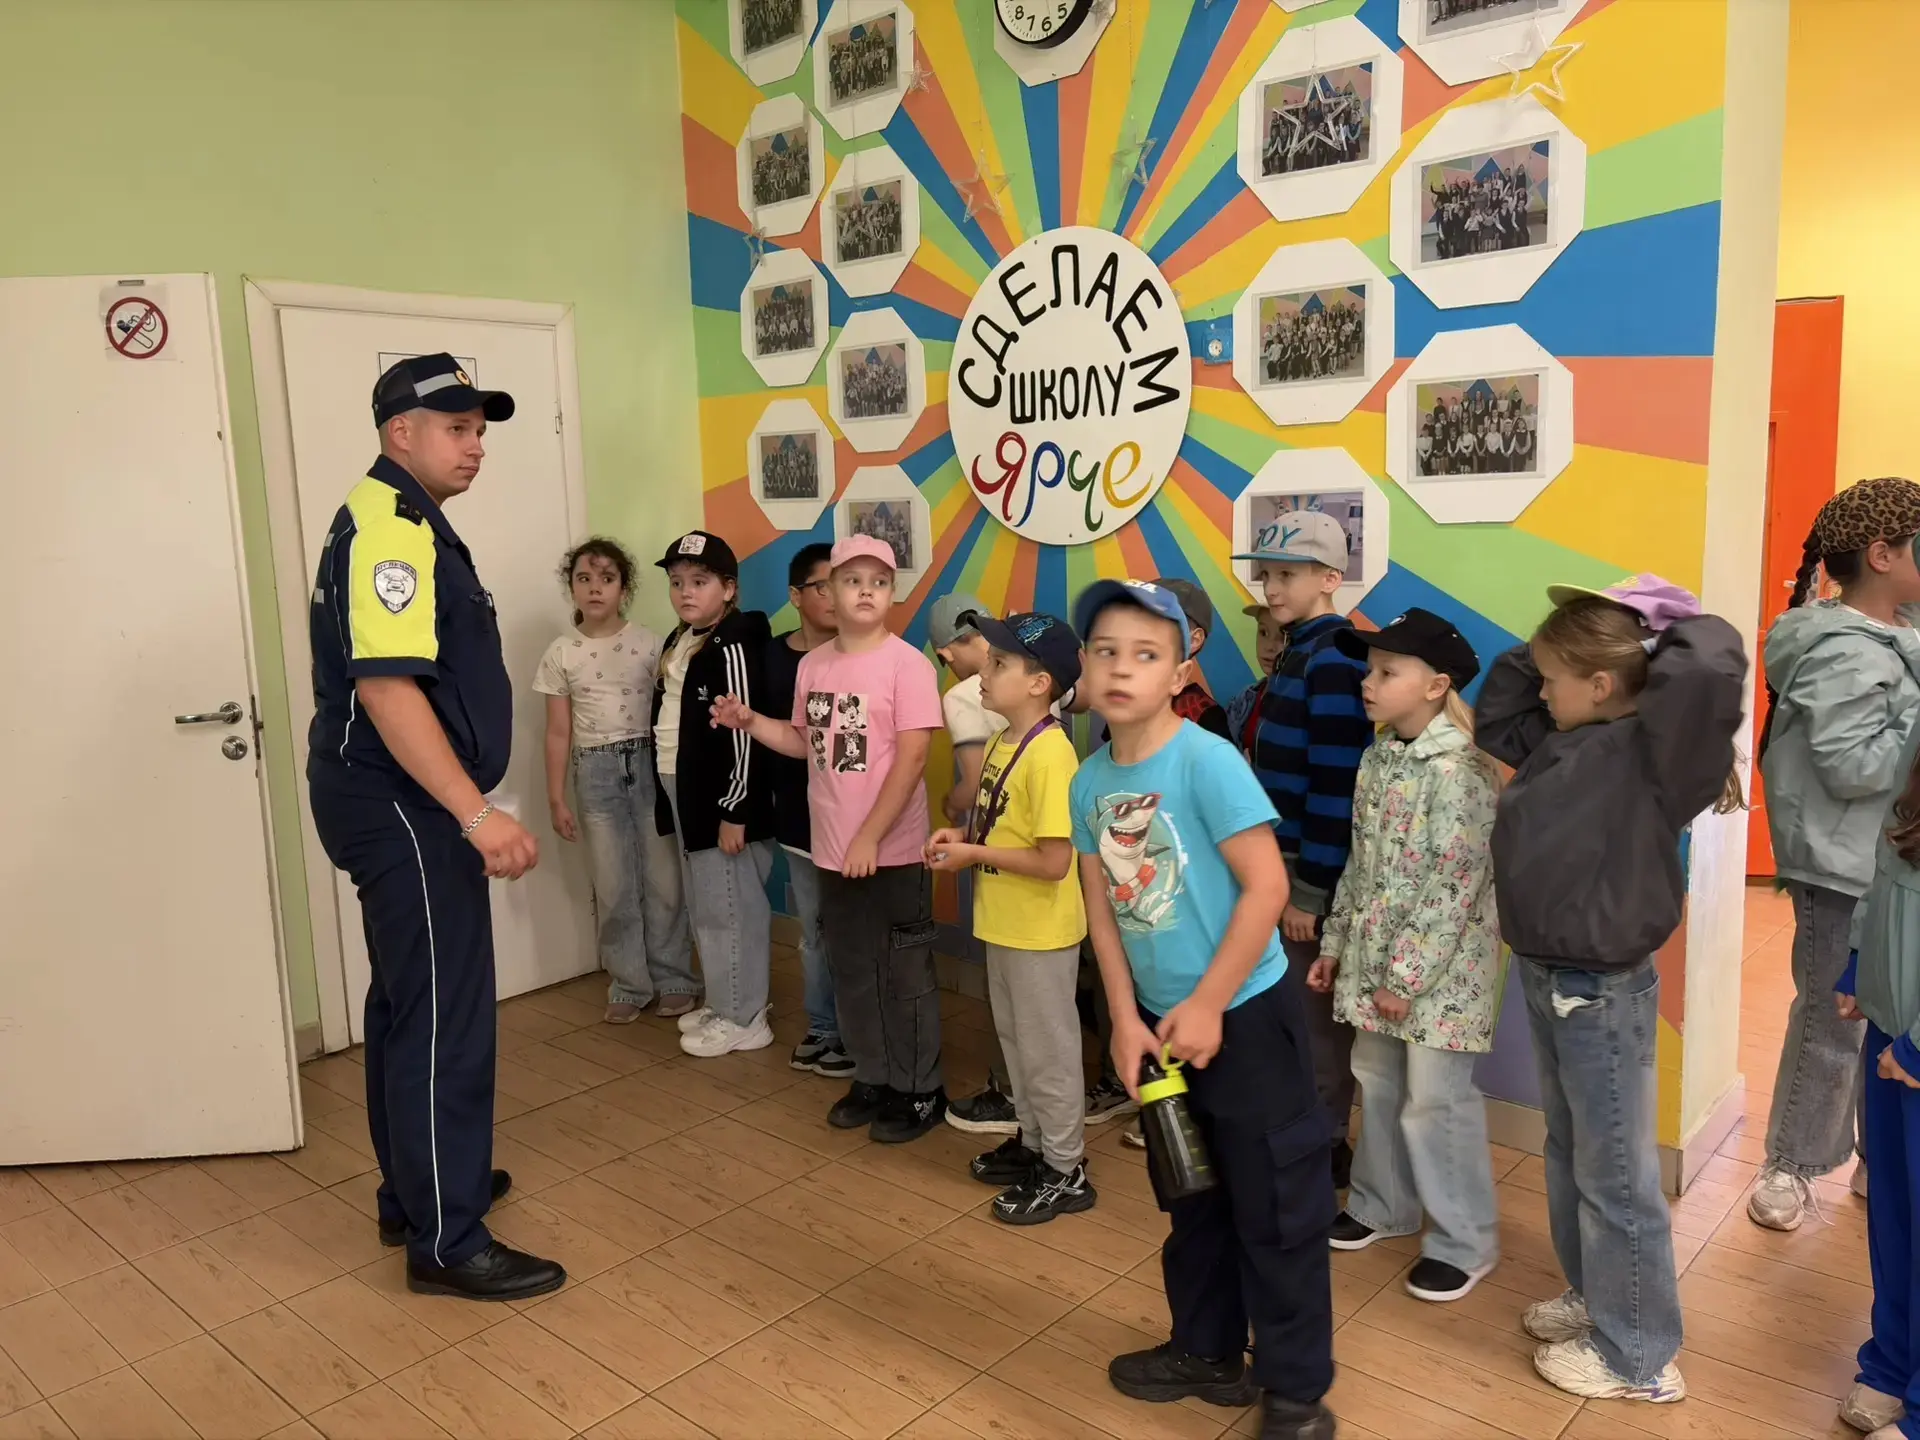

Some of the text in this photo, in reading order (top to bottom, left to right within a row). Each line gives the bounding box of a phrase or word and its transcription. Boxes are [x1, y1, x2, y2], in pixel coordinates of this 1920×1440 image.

[1015, 5, 1024, 20] 8
[1057, 3, 1068, 19] 5
[1027, 15, 1035, 31] 7
[1041, 16, 1052, 32] 6
[958, 244, 1180, 413] СДЕЛАЕМ
[1009, 361, 1125, 424] ШКОЛУ
